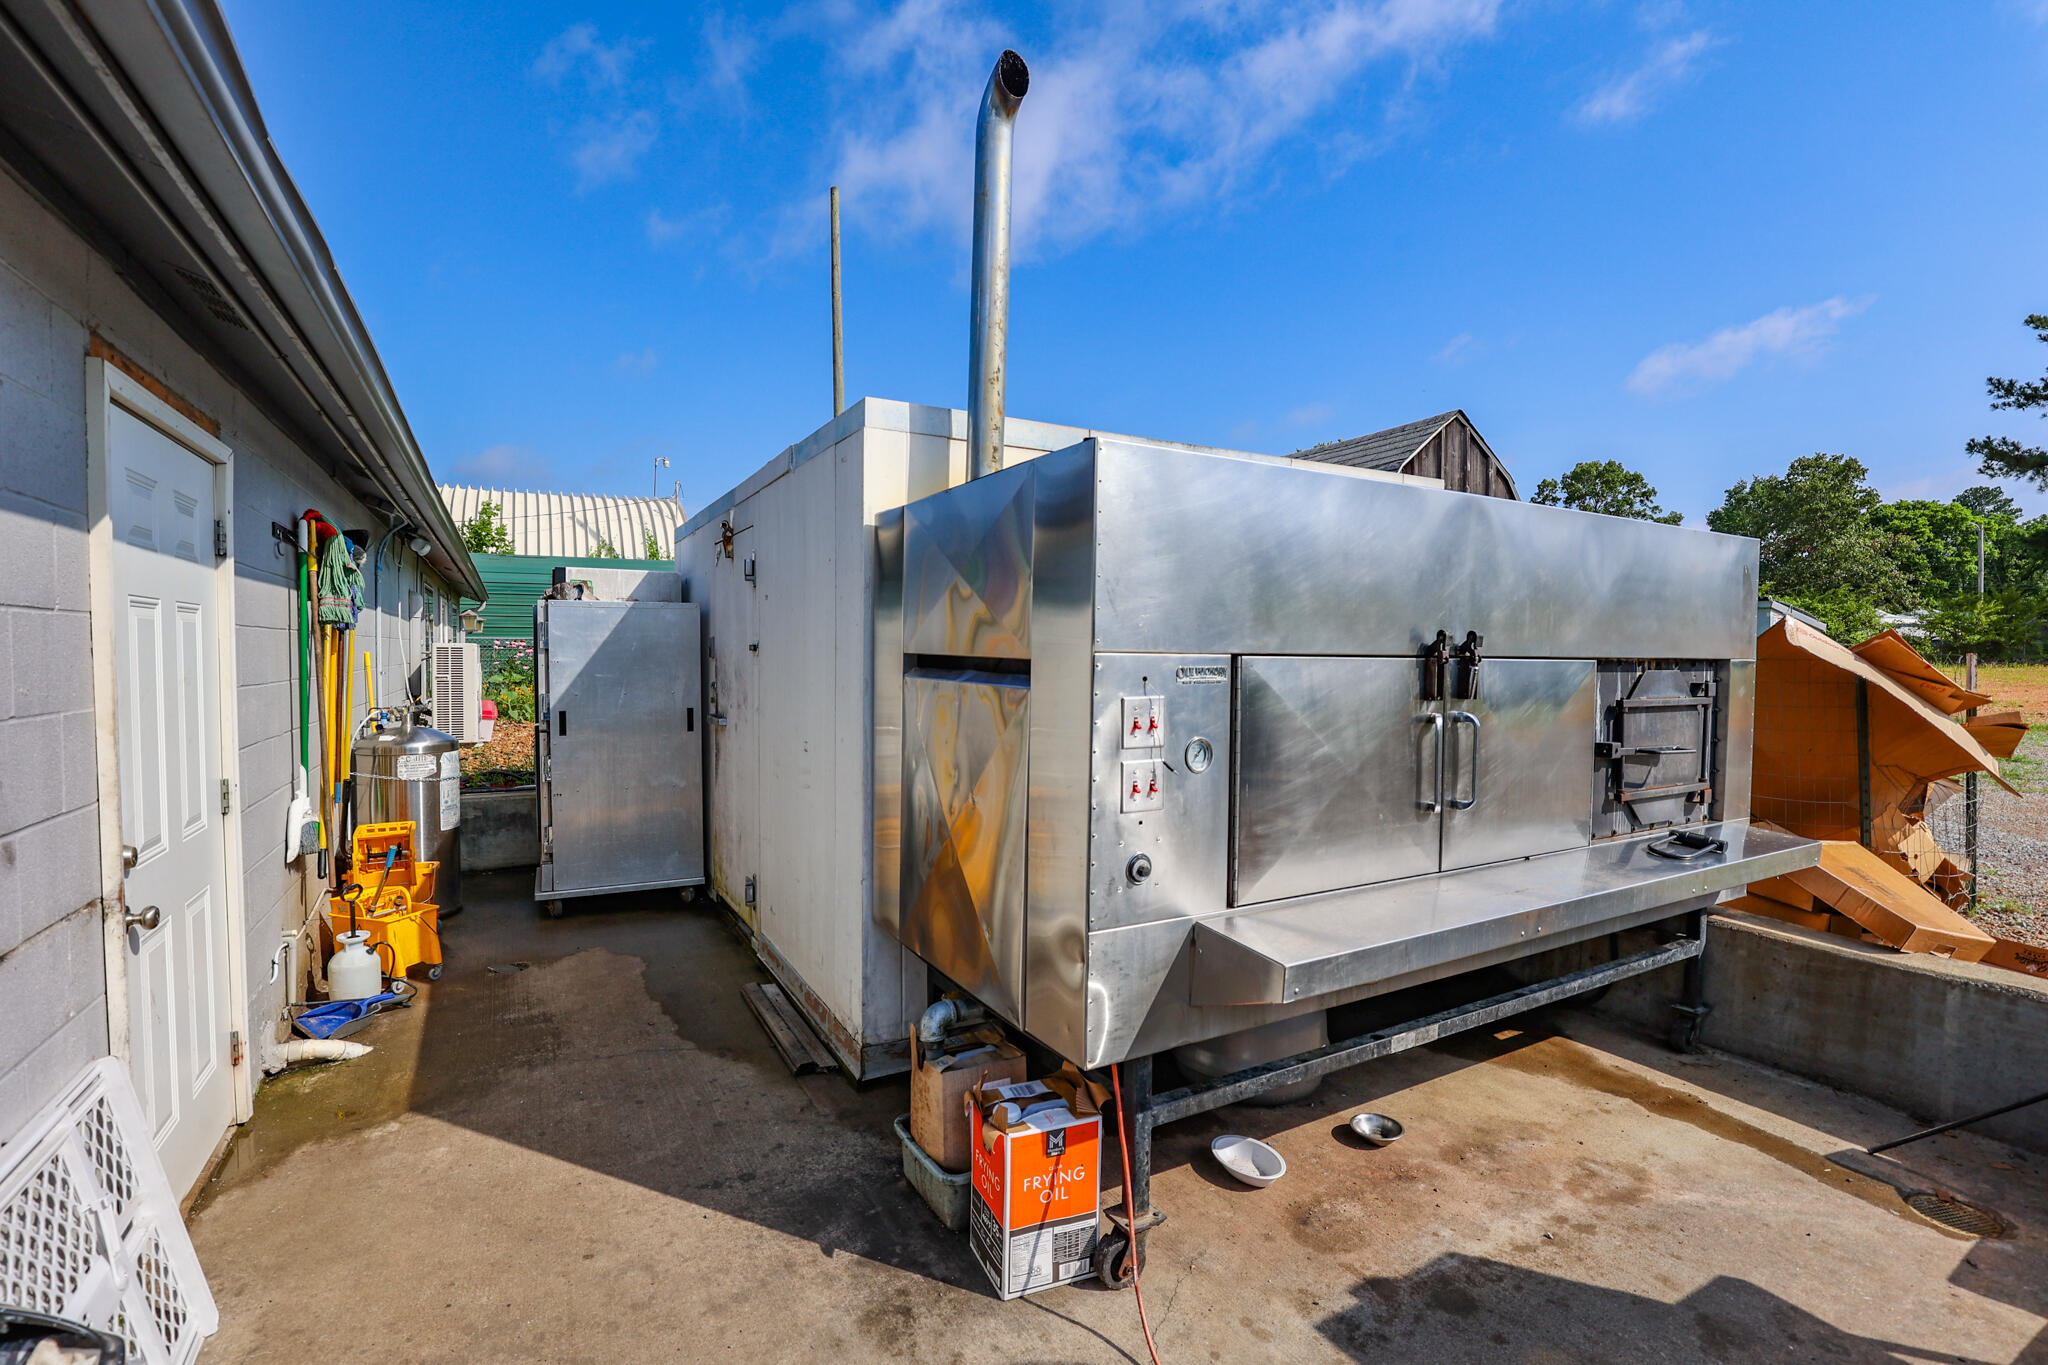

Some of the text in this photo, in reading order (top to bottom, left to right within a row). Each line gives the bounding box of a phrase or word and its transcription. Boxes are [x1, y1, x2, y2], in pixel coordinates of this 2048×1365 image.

[975, 1149, 1001, 1191] FRYING
[1023, 1166, 1085, 1192] FRYING
[981, 1174, 994, 1200] OIL
[1040, 1186, 1069, 1203] OIL
